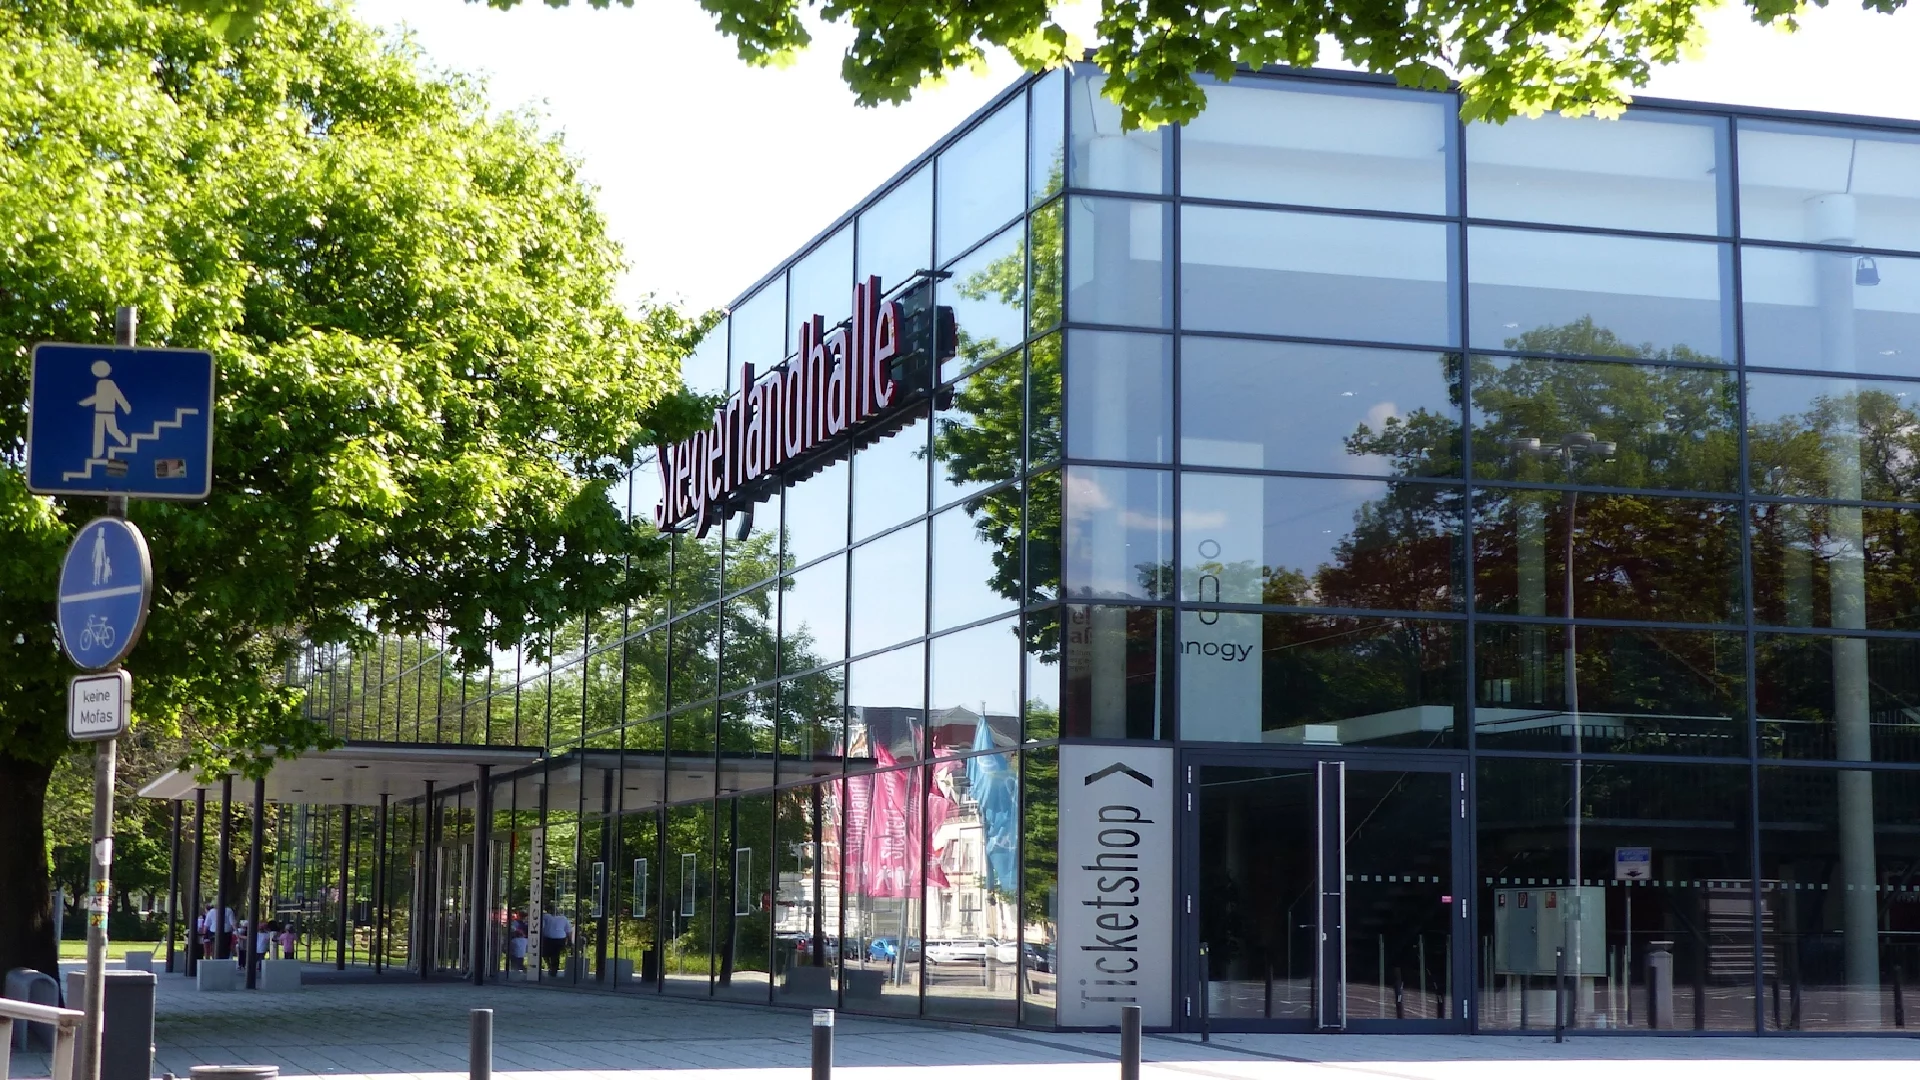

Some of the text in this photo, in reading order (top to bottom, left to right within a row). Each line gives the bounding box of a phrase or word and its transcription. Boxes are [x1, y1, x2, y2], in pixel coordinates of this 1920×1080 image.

[83, 689, 111, 703] keine
[80, 709, 113, 725] Mofas
[1080, 805, 1155, 1009] Ticketshop
